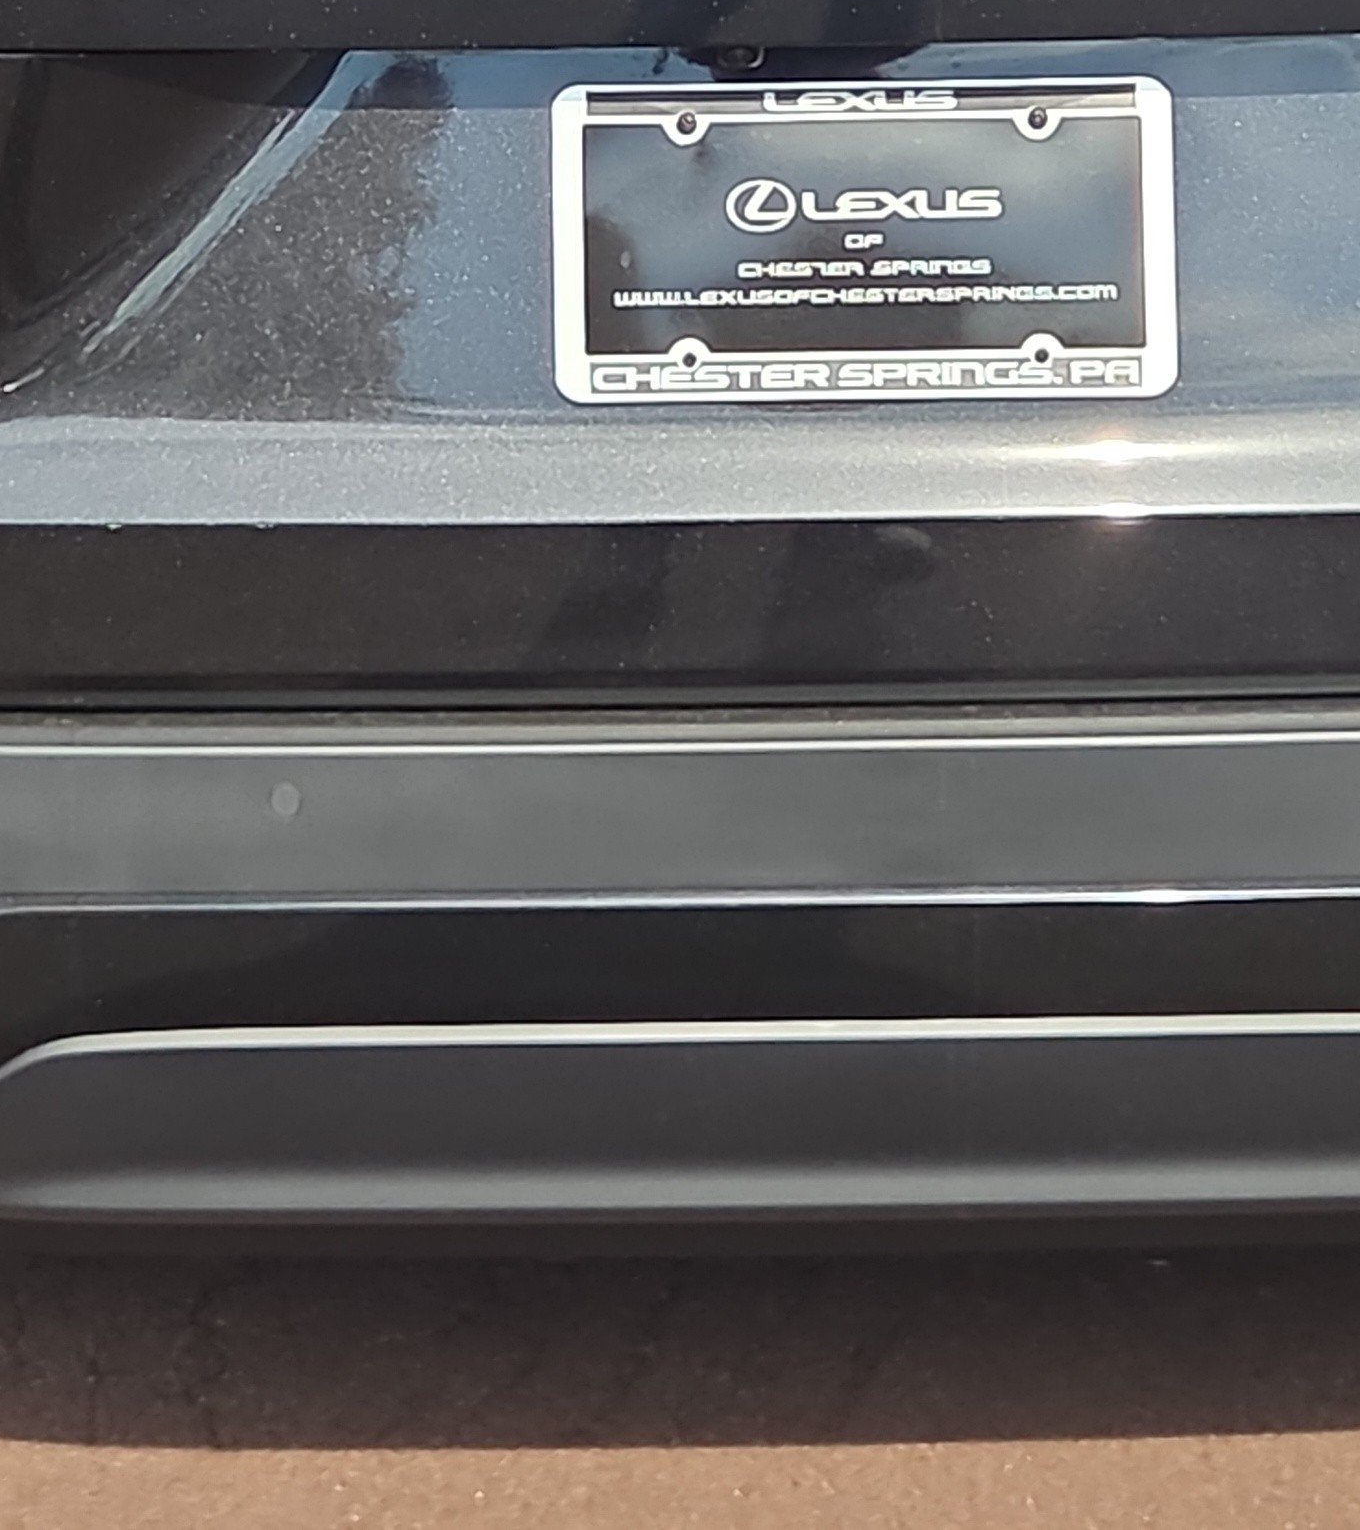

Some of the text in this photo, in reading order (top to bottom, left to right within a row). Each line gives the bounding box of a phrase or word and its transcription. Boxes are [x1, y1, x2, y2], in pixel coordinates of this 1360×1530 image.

[762, 88, 958, 112] LEXUS
[802, 188, 1003, 220] LEXUS
[844, 233, 883, 249] OF
[737, 258, 992, 279] CHESTER SPRINGS
[592, 363, 829, 391] CHESTER
[1071, 358, 1141, 384] PA
